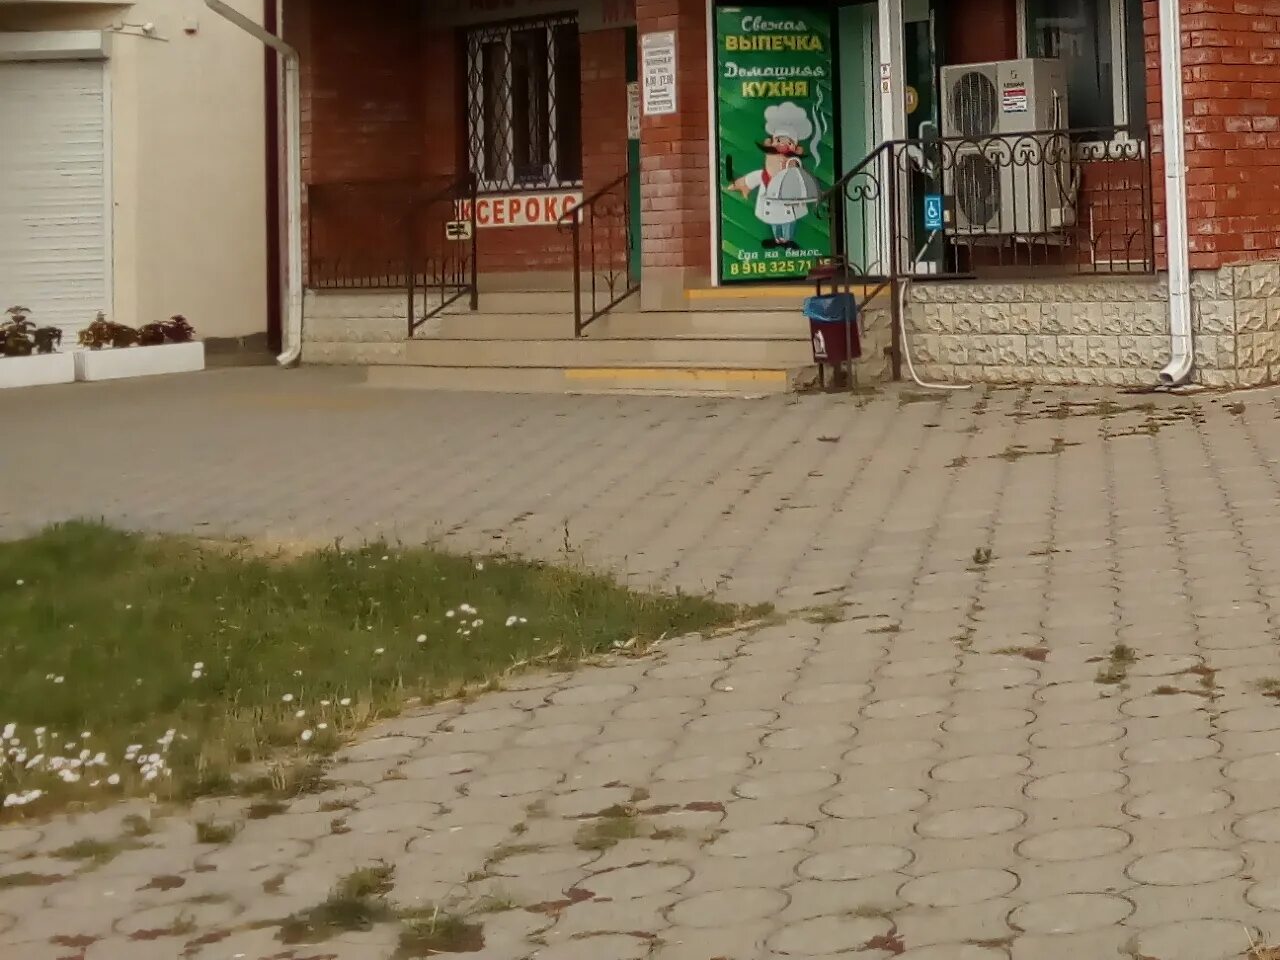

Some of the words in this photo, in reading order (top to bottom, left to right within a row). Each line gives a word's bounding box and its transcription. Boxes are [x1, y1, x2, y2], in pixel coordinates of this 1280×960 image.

[742, 15, 807, 32] Свежая
[725, 35, 822, 51] ВЫПЕЧКА
[724, 61, 824, 79] Домашняя
[742, 81, 808, 97] КУХНЯ
[765, 250, 779, 258] на
[730, 263, 739, 275] 8
[743, 261, 766, 274] 918
[769, 260, 795, 272] 325
[797, 259, 811, 271] 71
